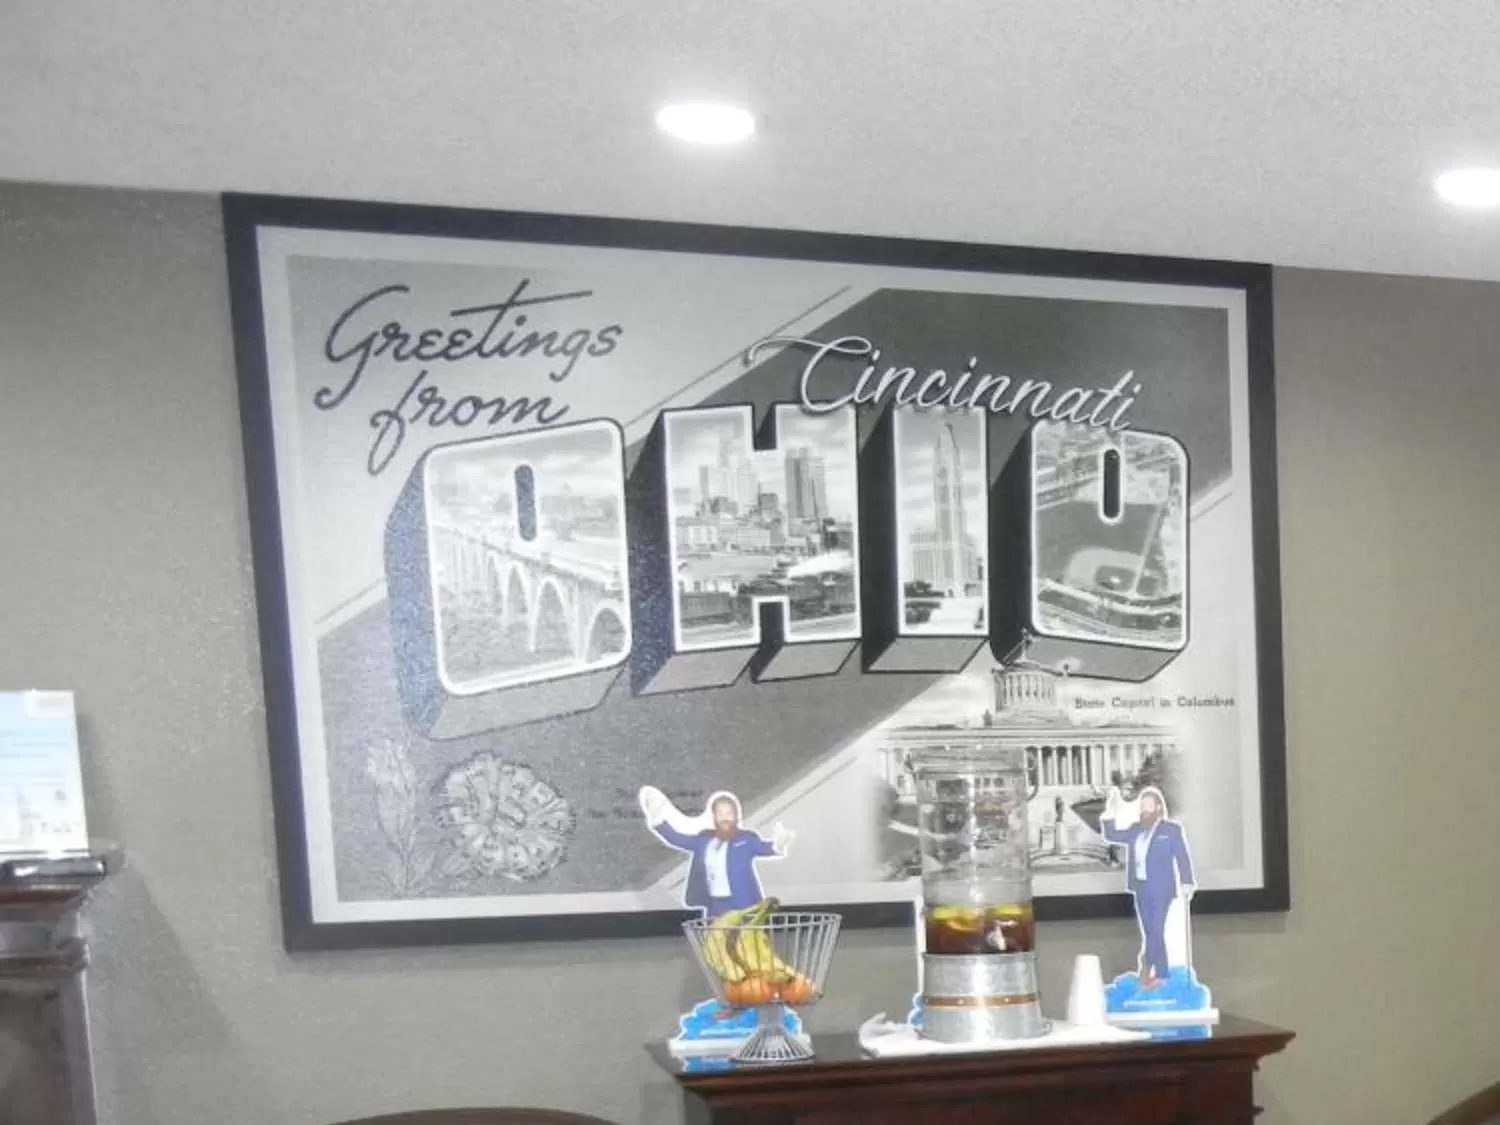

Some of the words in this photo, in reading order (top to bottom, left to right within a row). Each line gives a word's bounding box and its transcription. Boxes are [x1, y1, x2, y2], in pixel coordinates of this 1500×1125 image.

[313, 277, 623, 411] Greetings
[744, 335, 1142, 433] Cincinnati
[367, 369, 570, 477] from
[405, 402, 1192, 708] OHIO
